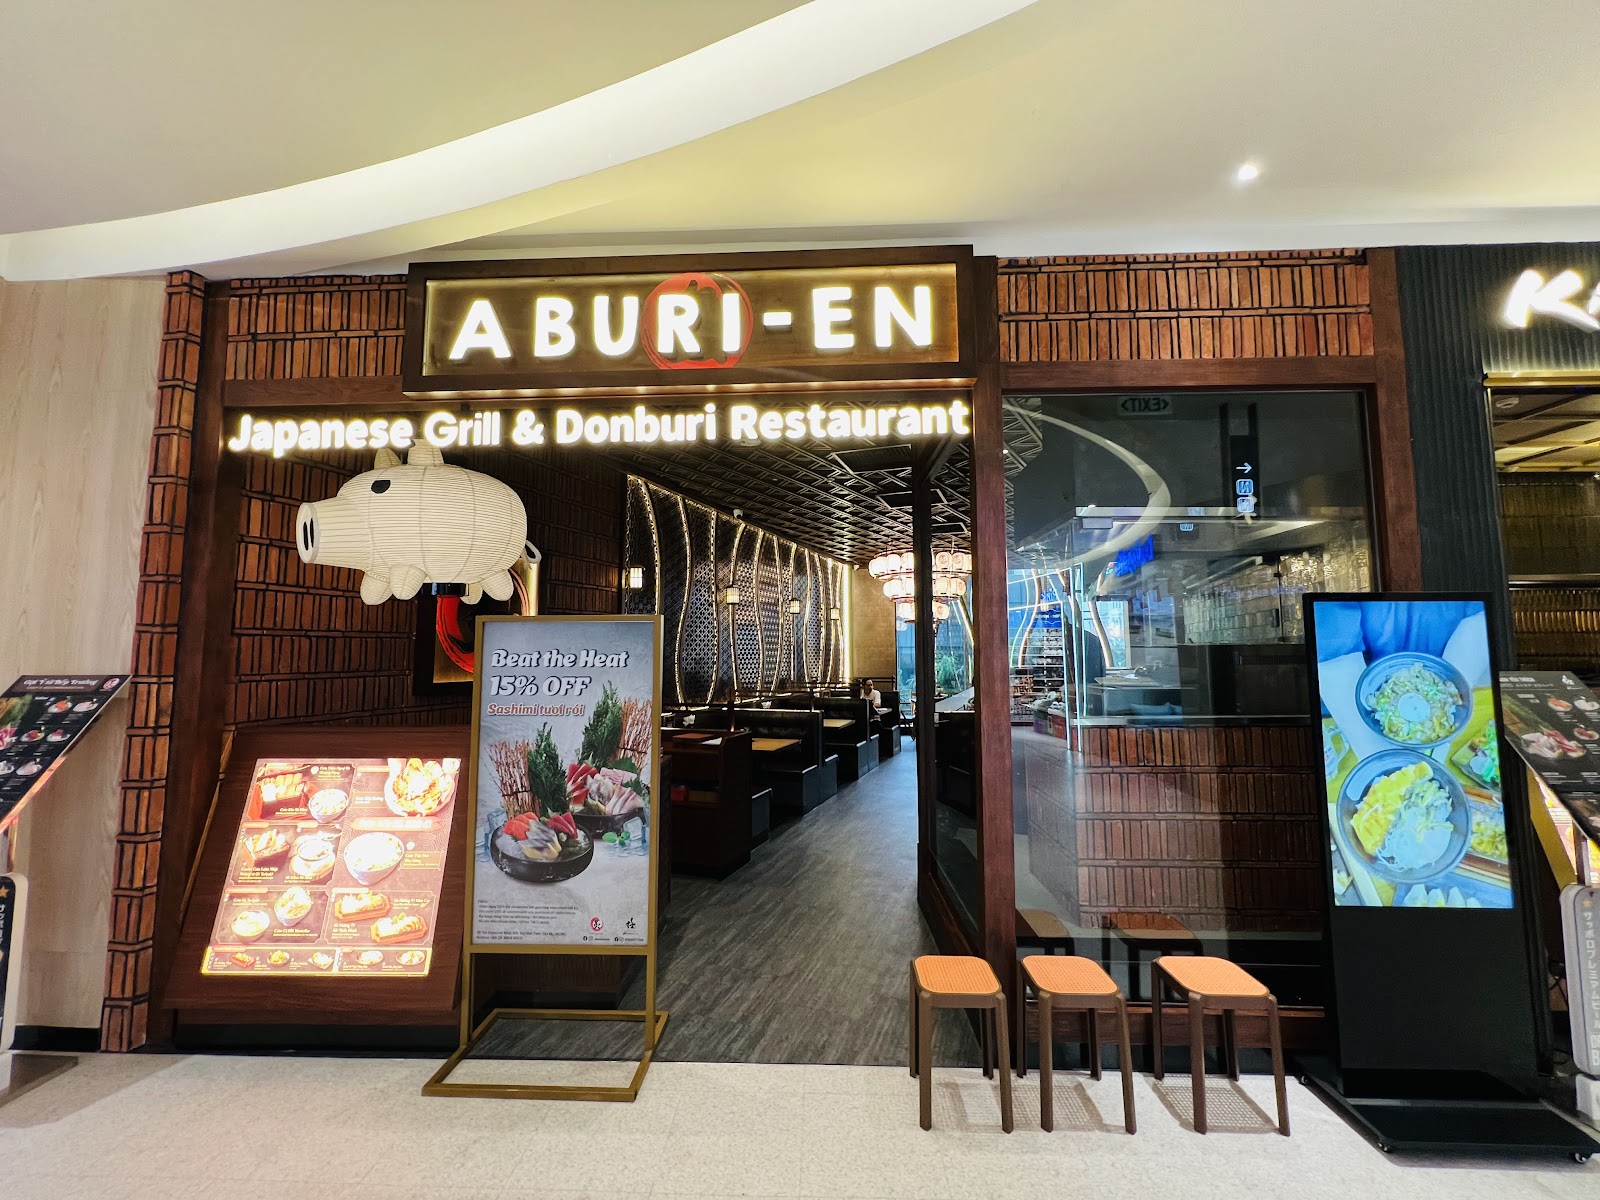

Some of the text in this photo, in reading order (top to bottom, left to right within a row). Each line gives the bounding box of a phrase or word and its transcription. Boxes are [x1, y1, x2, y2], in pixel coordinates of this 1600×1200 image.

[449, 286, 932, 360] ABURI-EN
[228, 400, 970, 458] Japanese Grill & Donburi Restaurant
[491, 649, 629, 667] Beat the Heat
[490, 675, 592, 696] 15% OFF
[487, 703, 539, 716] Sashimi
